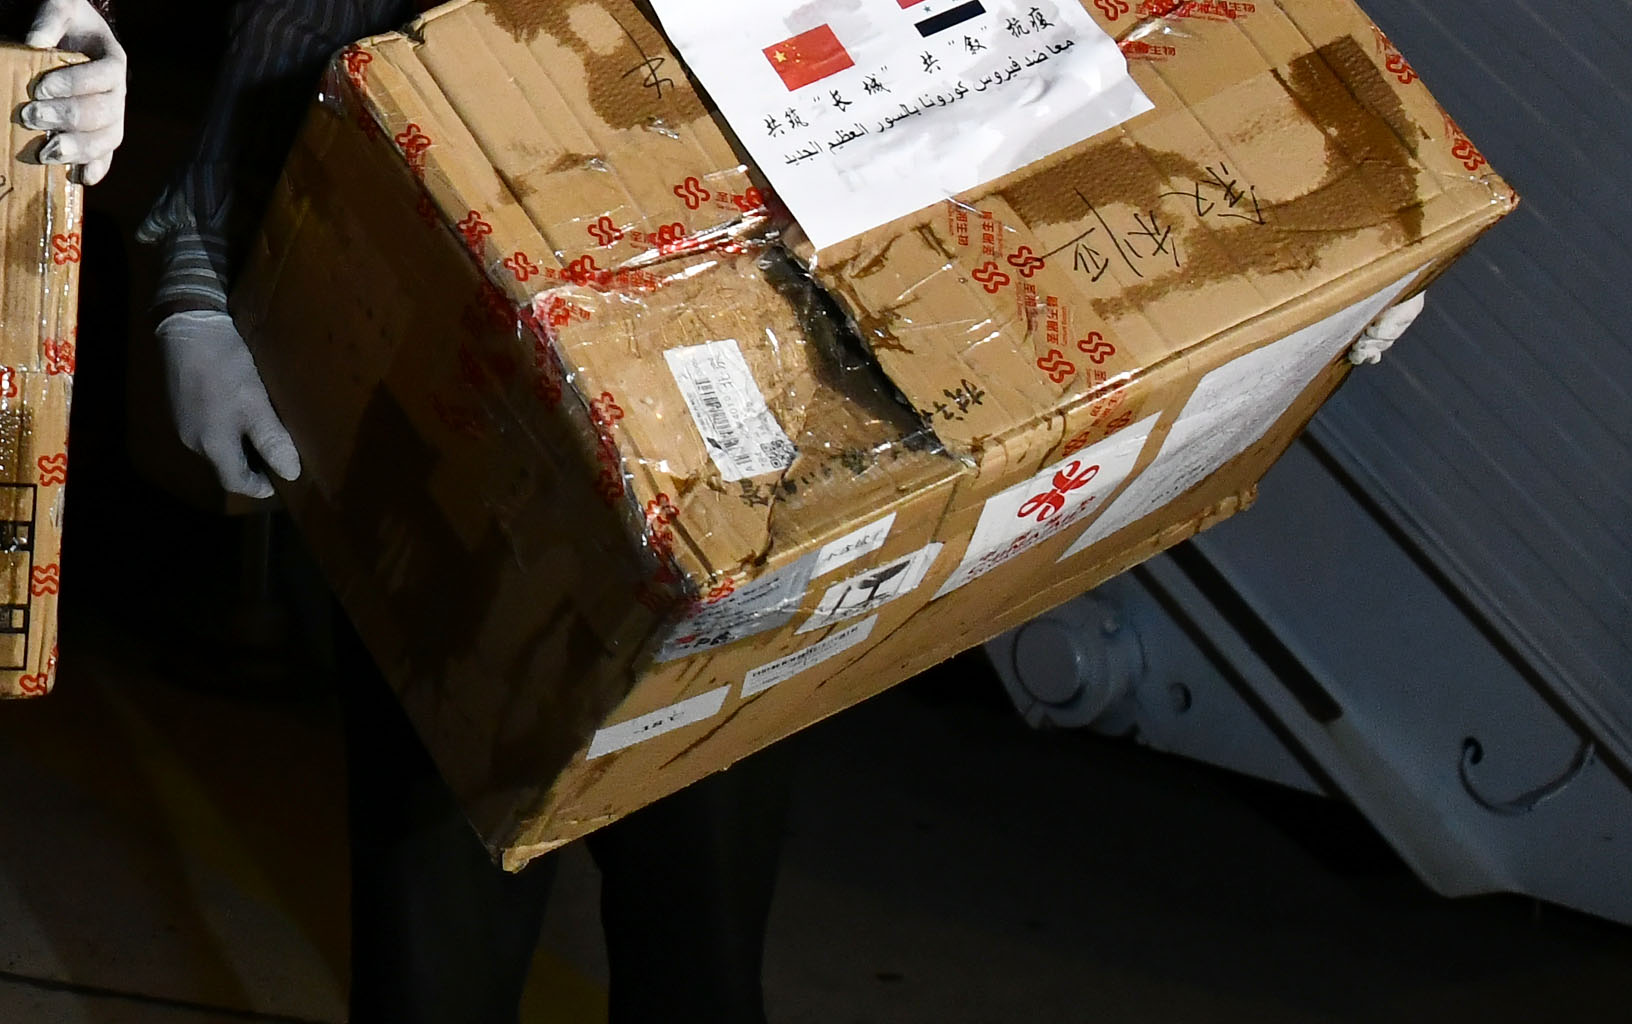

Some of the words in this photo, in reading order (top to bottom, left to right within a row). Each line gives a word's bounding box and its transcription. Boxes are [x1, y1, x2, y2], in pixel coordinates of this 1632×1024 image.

[973, 56, 1022, 91] فيروس
[919, 80, 969, 108] كورونا
[876, 103, 922, 133] بالسور
[784, 141, 824, 166] الجديد
[828, 123, 870, 154] العظيم
